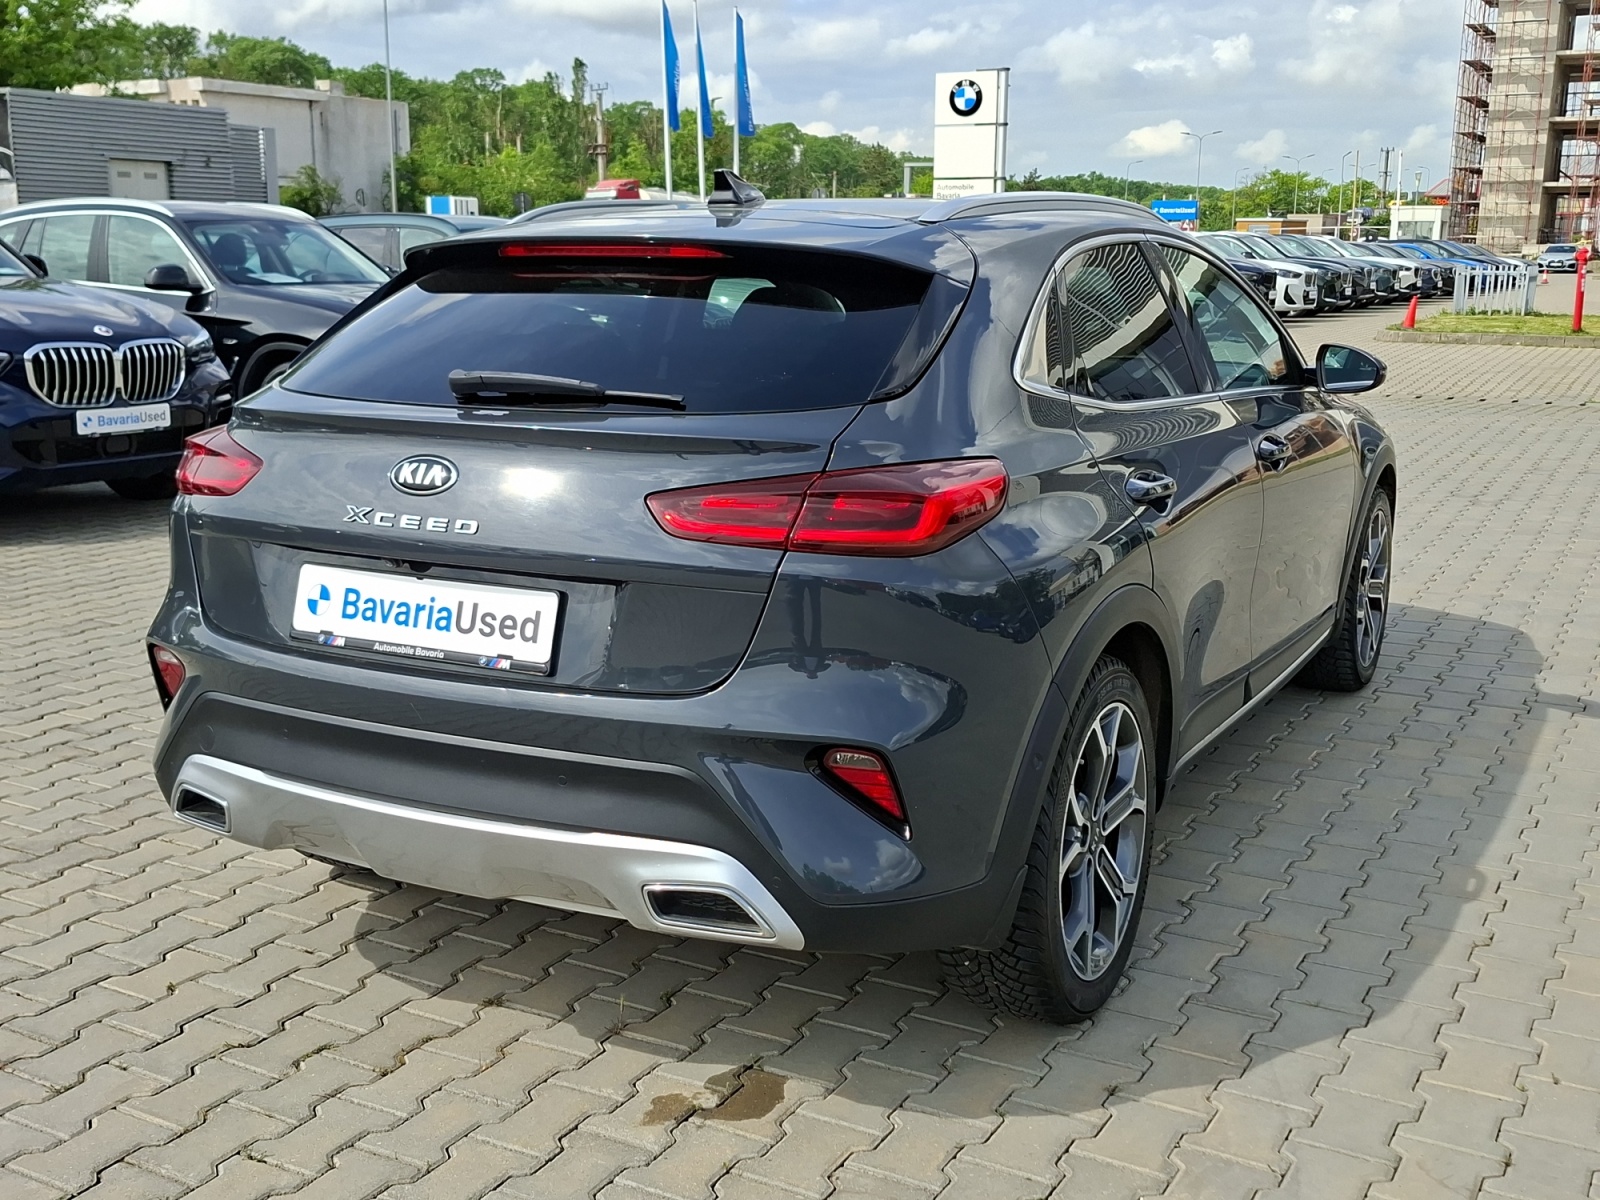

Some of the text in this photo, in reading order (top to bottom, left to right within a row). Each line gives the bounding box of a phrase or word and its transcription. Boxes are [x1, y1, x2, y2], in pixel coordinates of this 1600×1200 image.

[98, 410, 166, 427] BavariaUsed
[398, 462, 443, 486] KIA
[343, 505, 479, 535] XCEED
[341, 587, 541, 644] BavariaUsed
[373, 642, 444, 659] Automobile Bavaria
